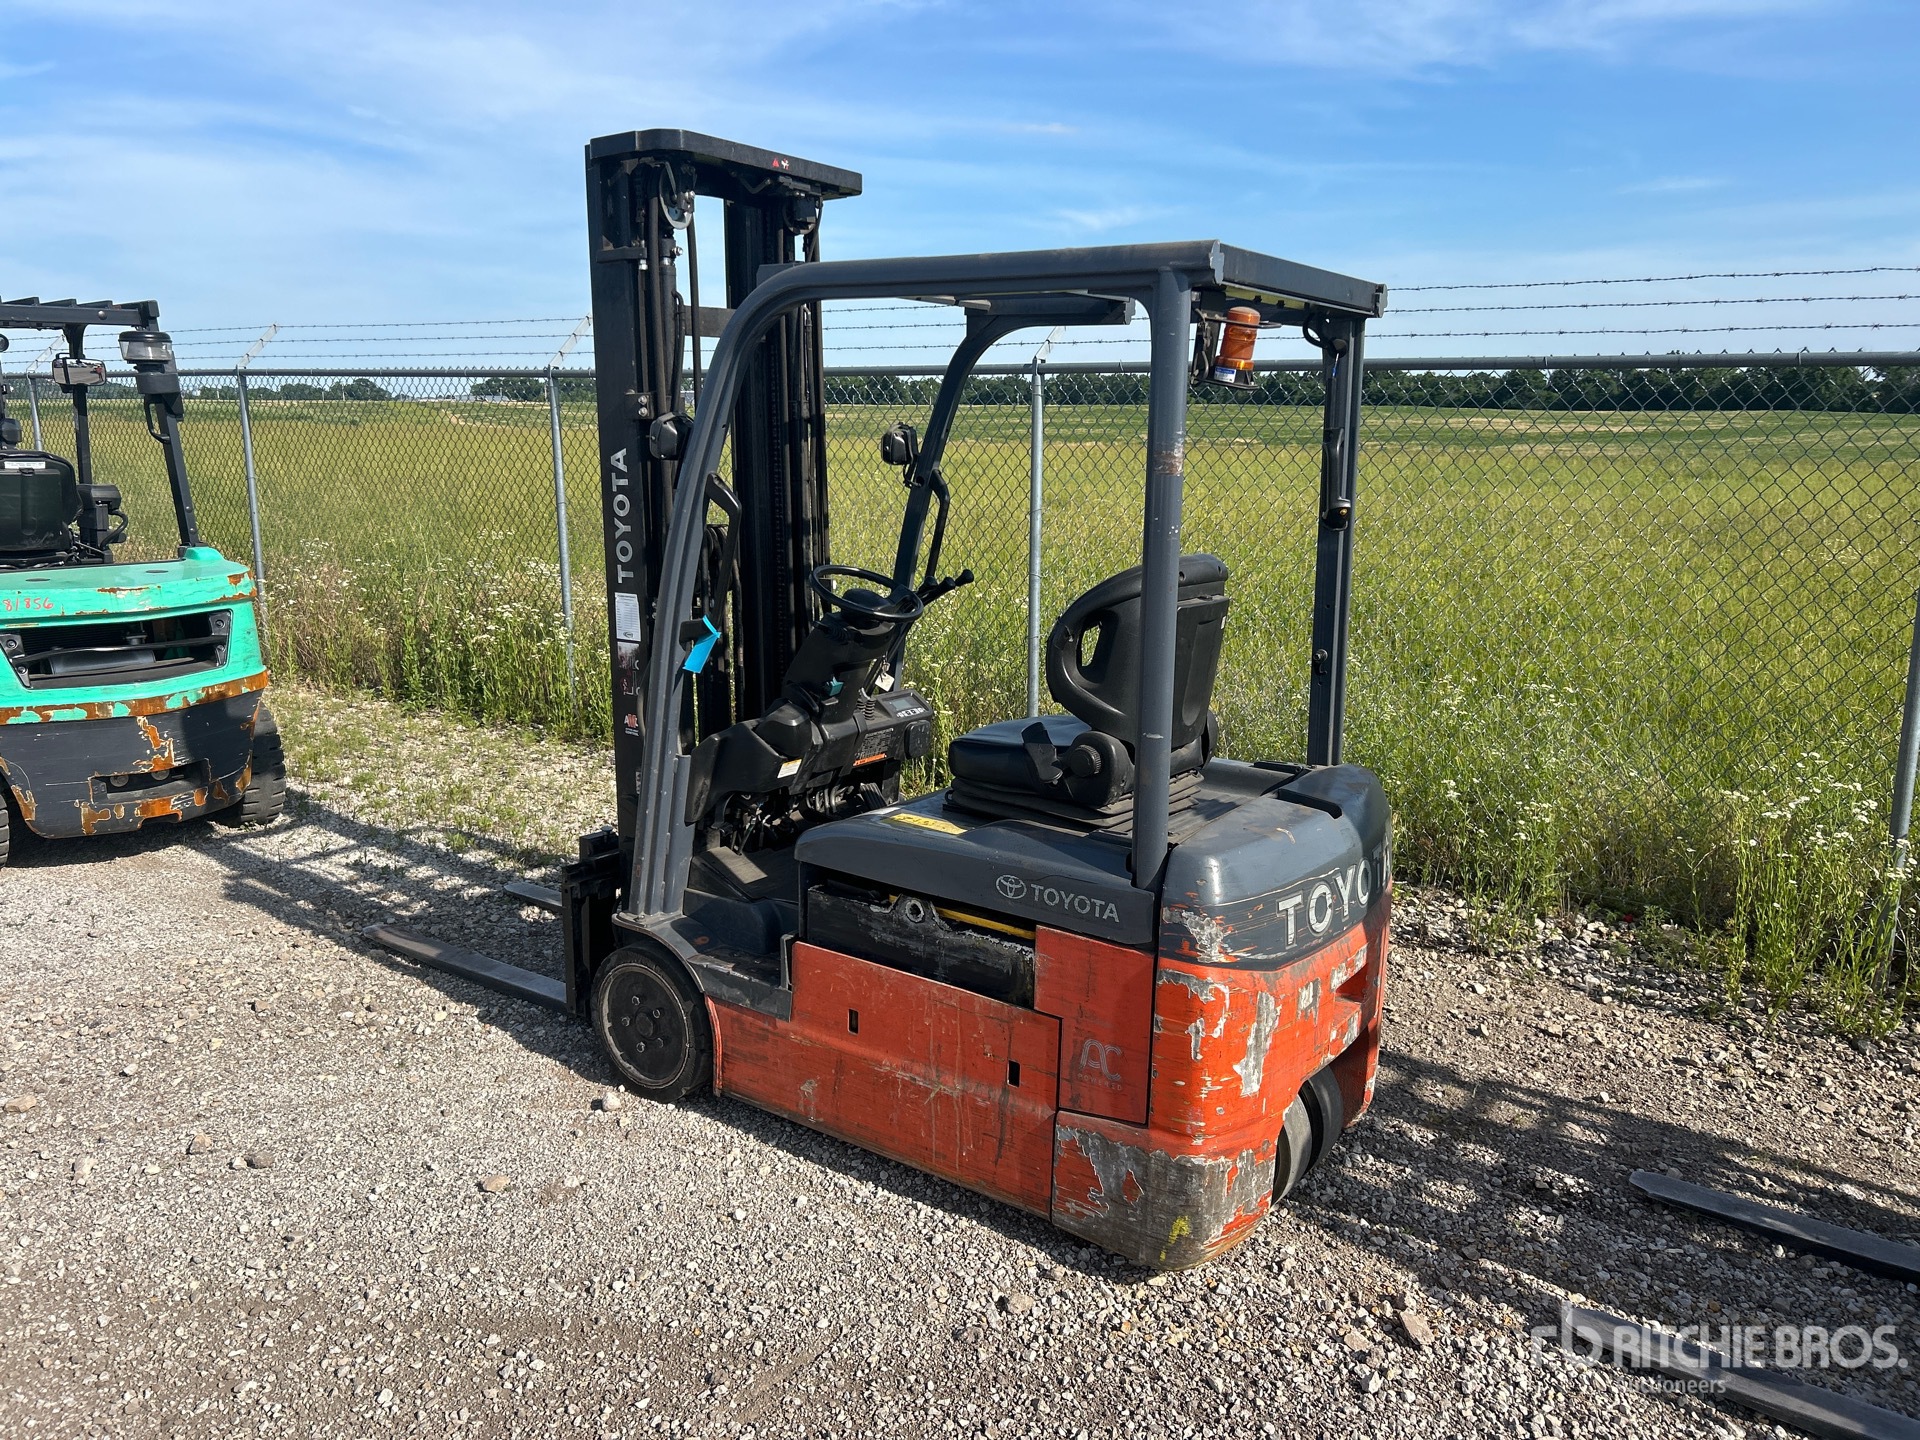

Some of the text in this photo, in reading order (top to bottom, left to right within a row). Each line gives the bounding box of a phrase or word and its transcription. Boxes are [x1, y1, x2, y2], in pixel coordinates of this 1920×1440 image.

[610, 447, 634, 584] TOYOTA
[1030, 883, 1120, 923] TOYOTA
[1080, 1039, 1123, 1081] AC
